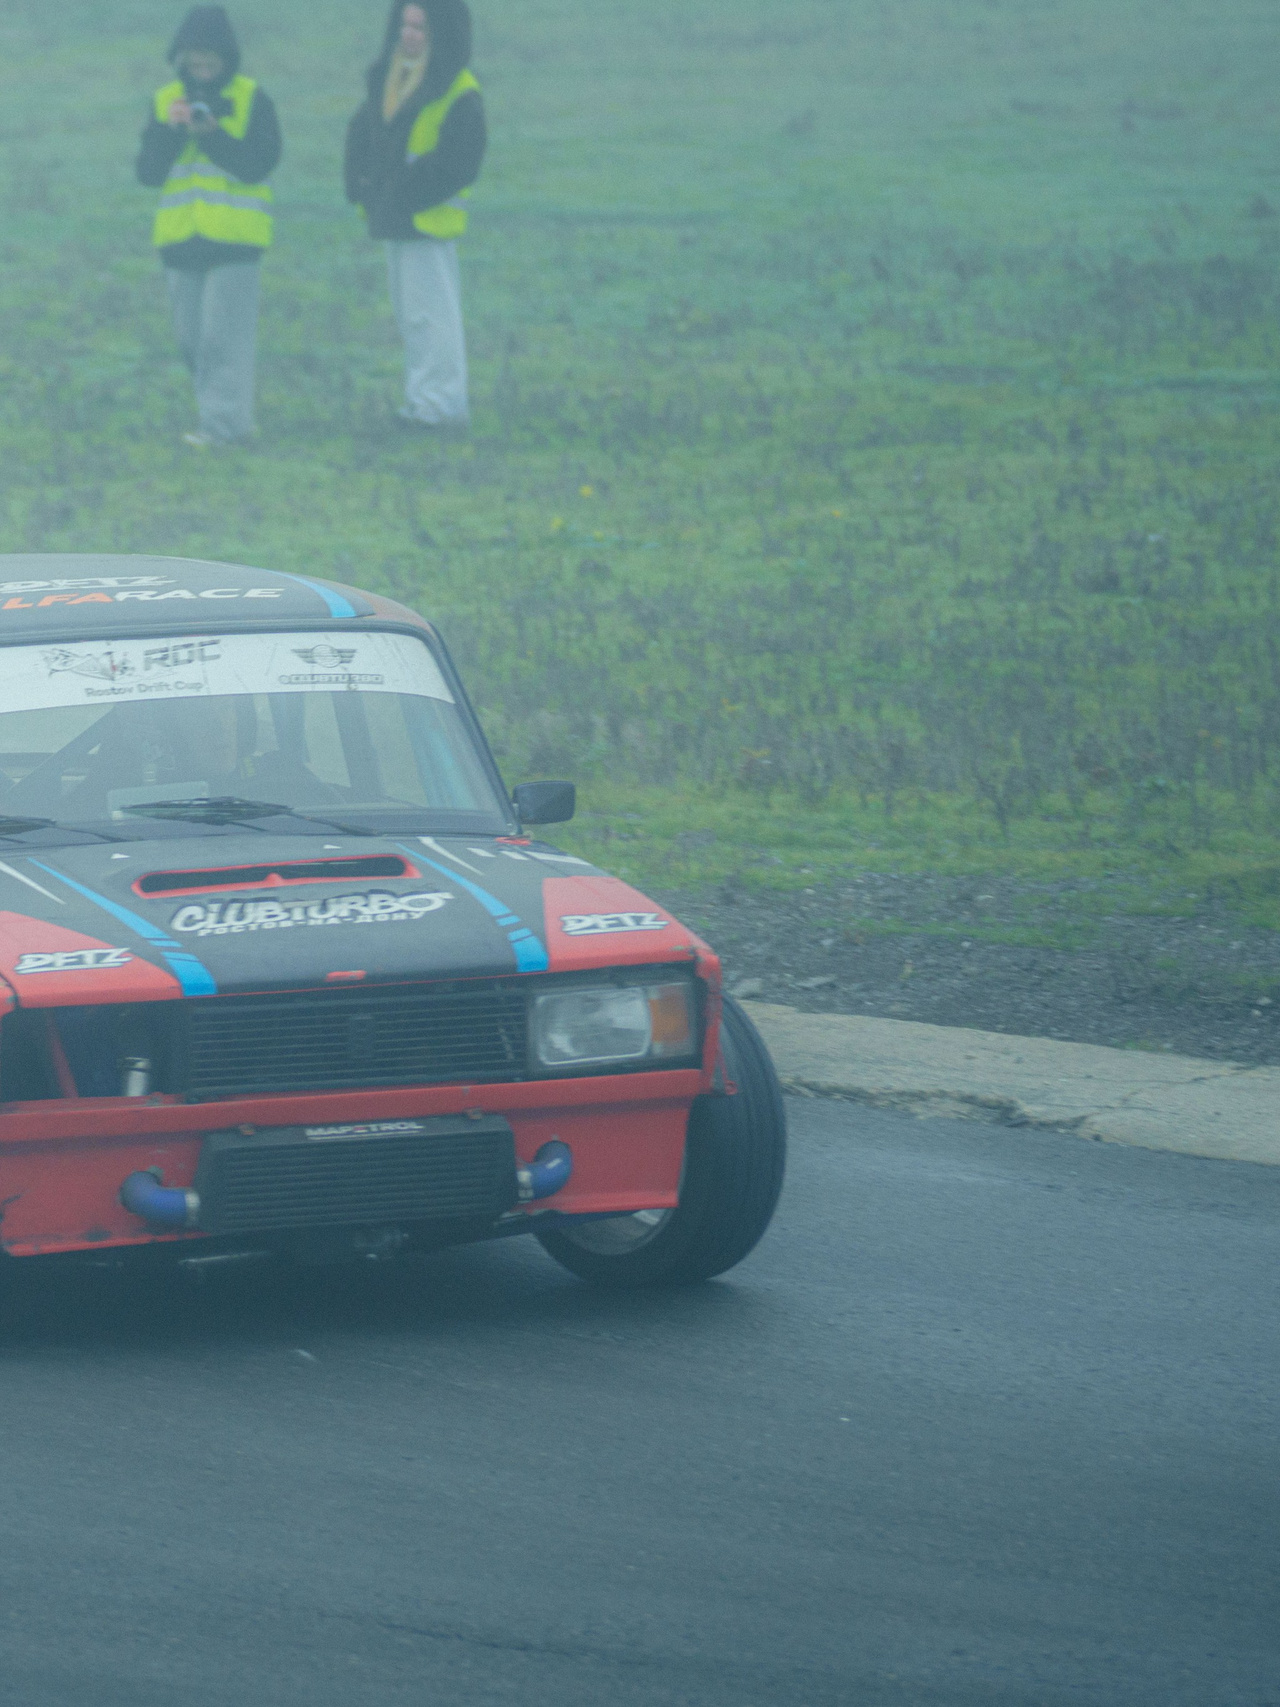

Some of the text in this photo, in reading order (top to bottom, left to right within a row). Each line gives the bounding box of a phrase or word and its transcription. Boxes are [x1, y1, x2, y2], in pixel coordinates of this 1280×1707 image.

[84, 680, 204, 698] Rostov Drift Cup
[171, 891, 455, 932] CLUBTURBO
[197, 911, 427, 937] РОСТОВ-НА-ДОНУ
[305, 1121, 425, 1136] MAPETROL
